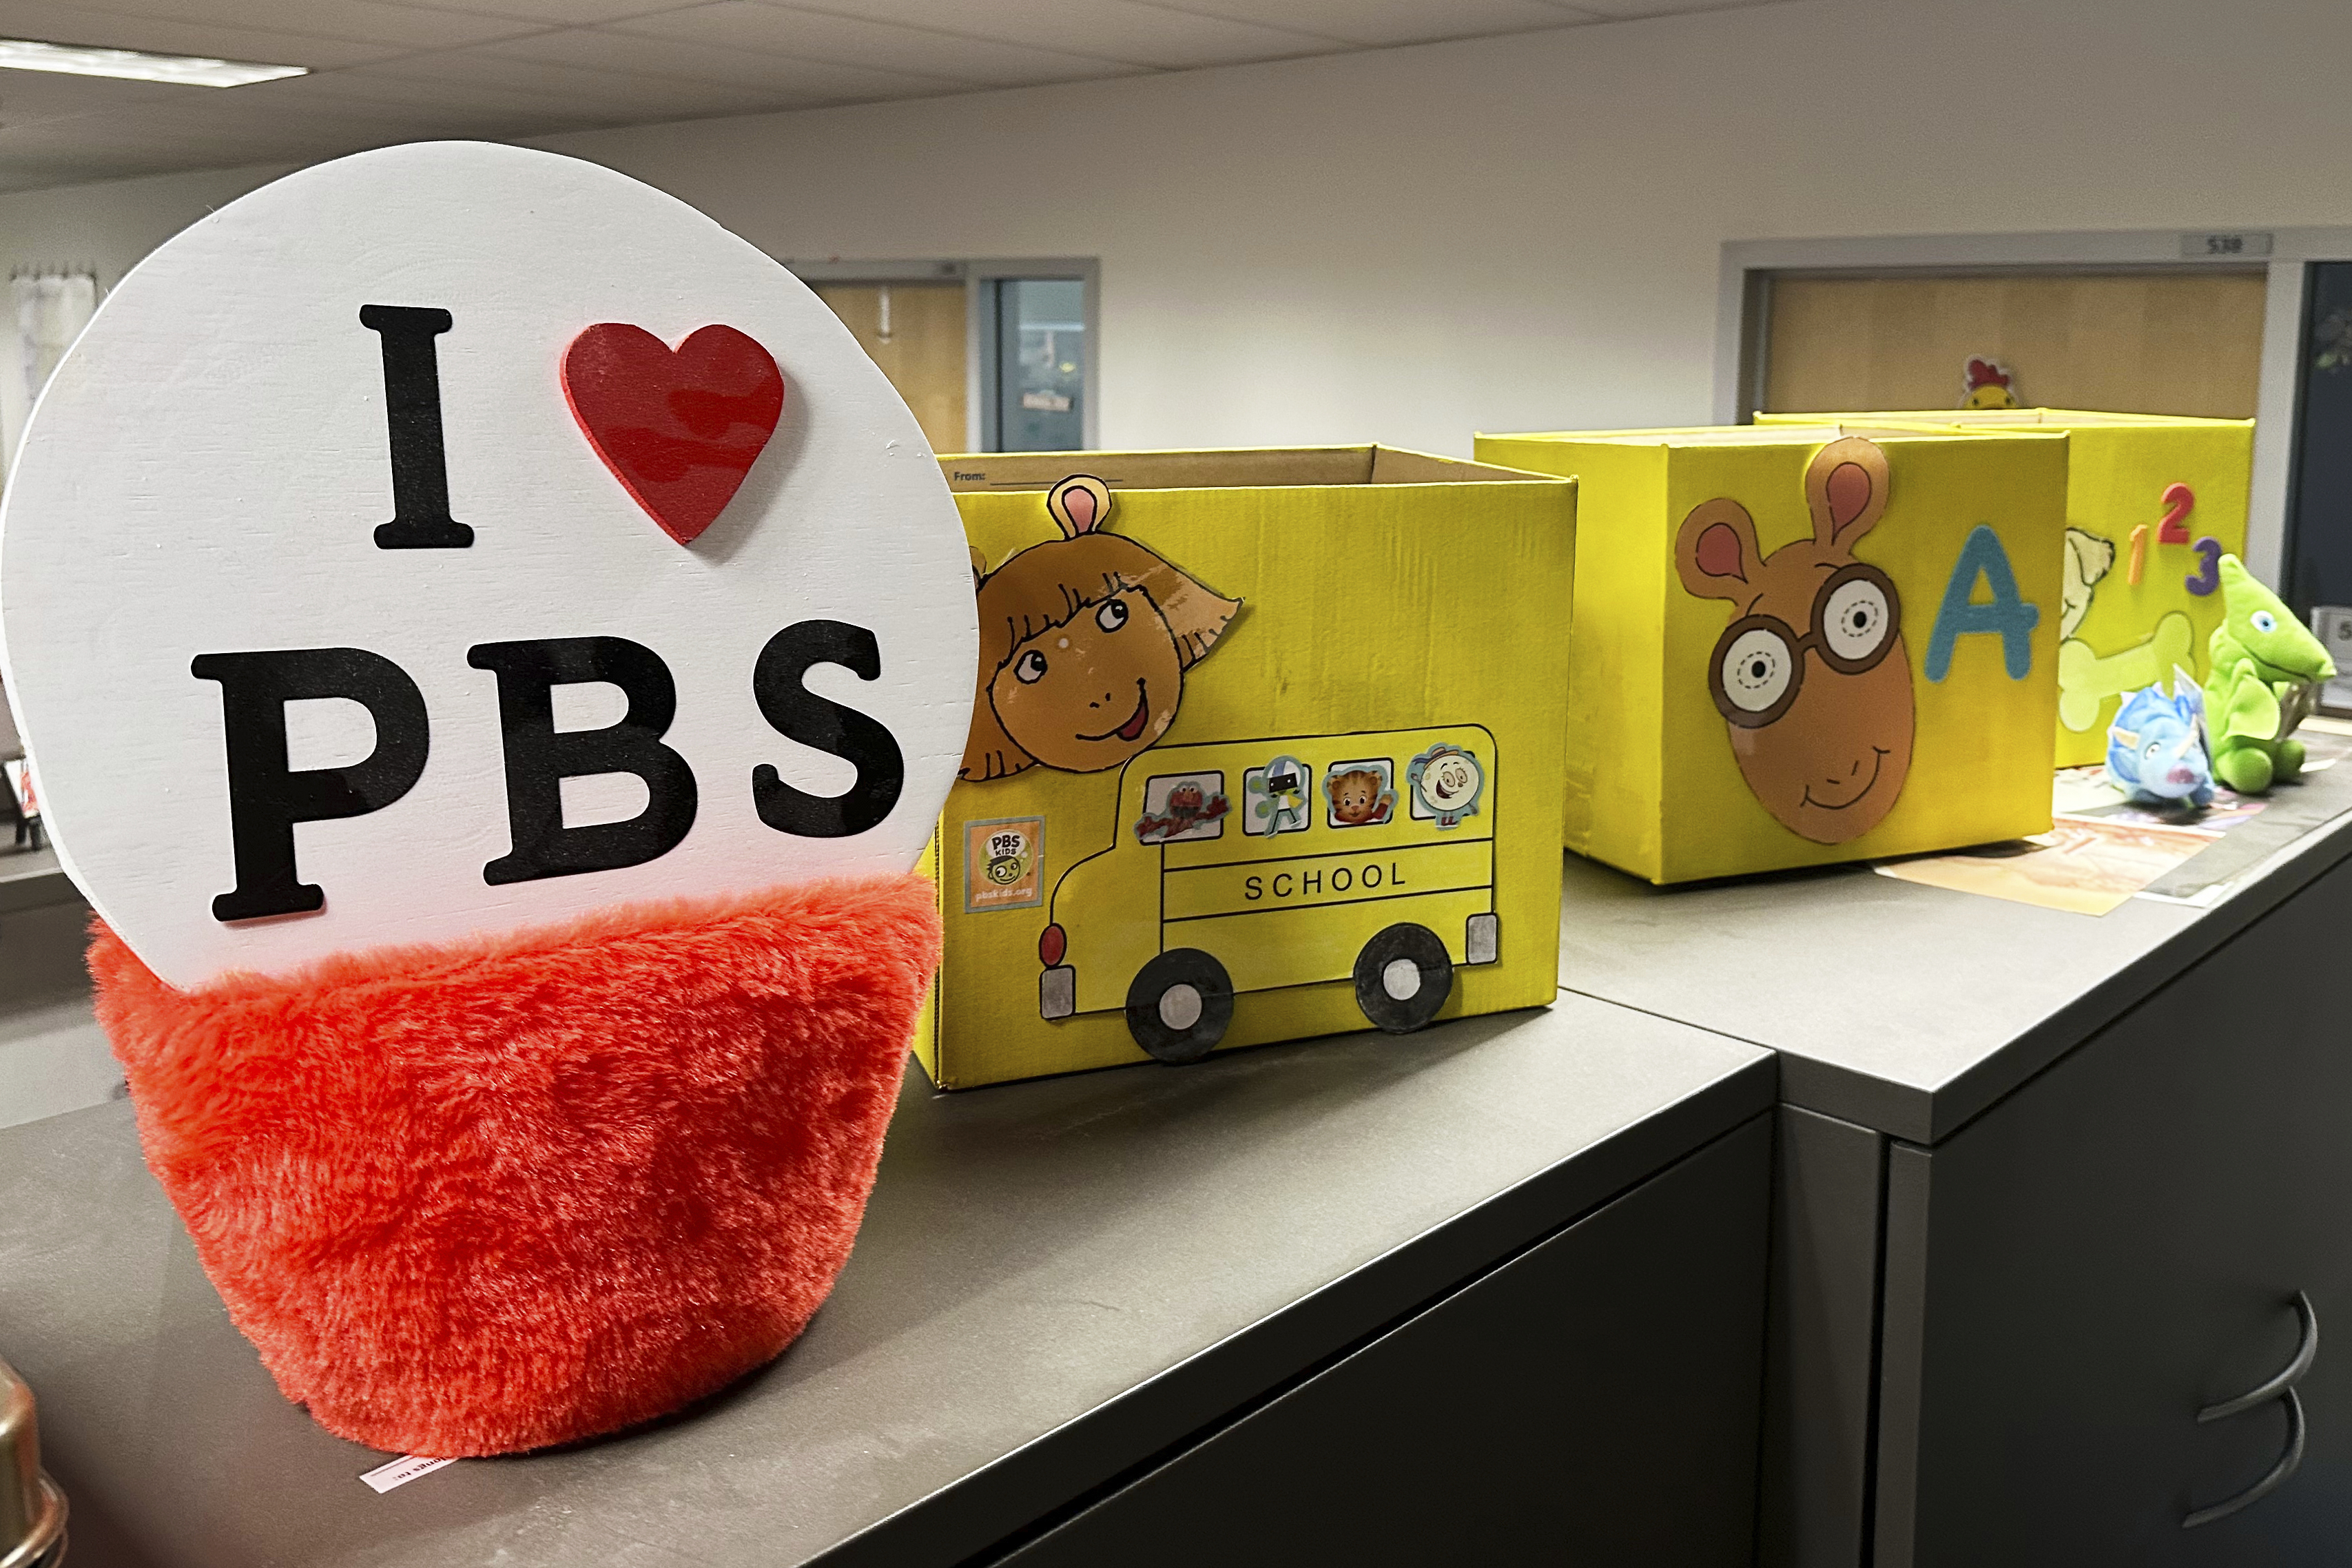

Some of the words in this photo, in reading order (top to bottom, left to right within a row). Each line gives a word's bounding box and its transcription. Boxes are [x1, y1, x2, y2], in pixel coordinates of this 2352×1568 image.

[360, 305, 475, 549] I
[954, 471, 986, 481] From:
[1923, 524, 2040, 683] A
[191, 619, 905, 922] PBS
[991, 834, 1020, 850] PBS
[995, 848, 1017, 856] KIDS
[974, 887, 1032, 902] pbskids.org
[1244, 862, 1406, 900] SCHOOL
